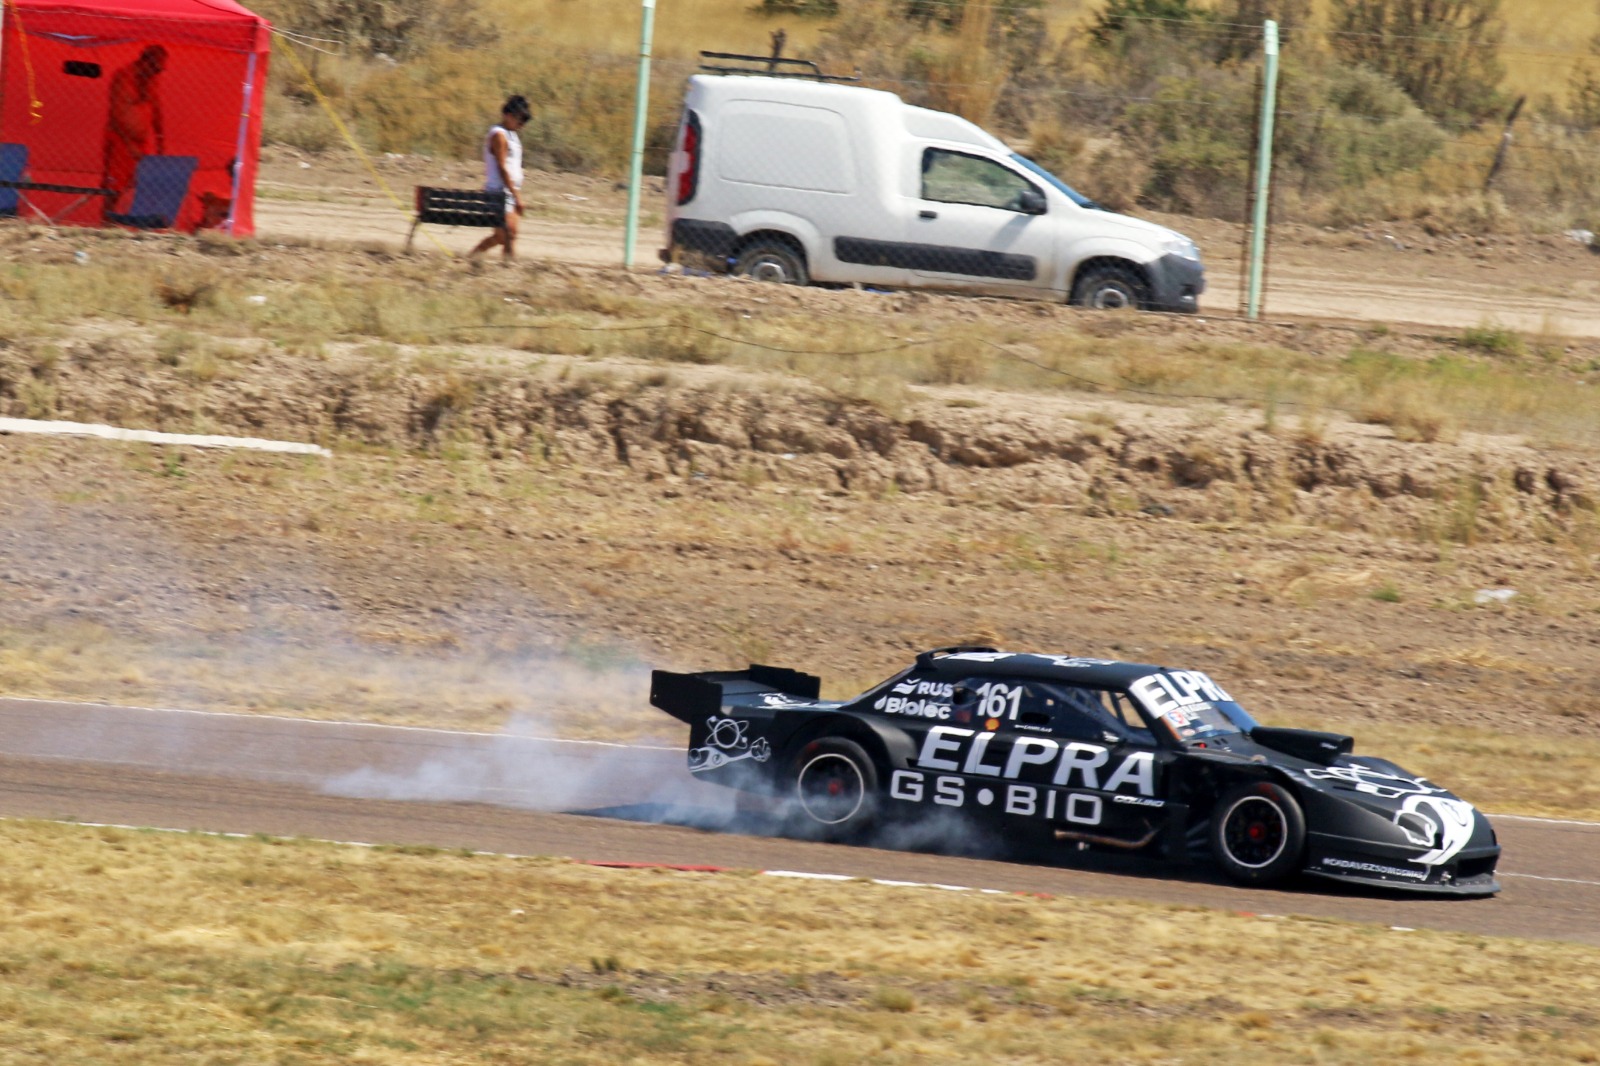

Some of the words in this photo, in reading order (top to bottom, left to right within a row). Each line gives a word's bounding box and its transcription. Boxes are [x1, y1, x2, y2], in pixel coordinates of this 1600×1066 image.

[917, 681, 954, 698] RUS
[976, 682, 1023, 721] 161
[917, 726, 1155, 796] ELPRA
